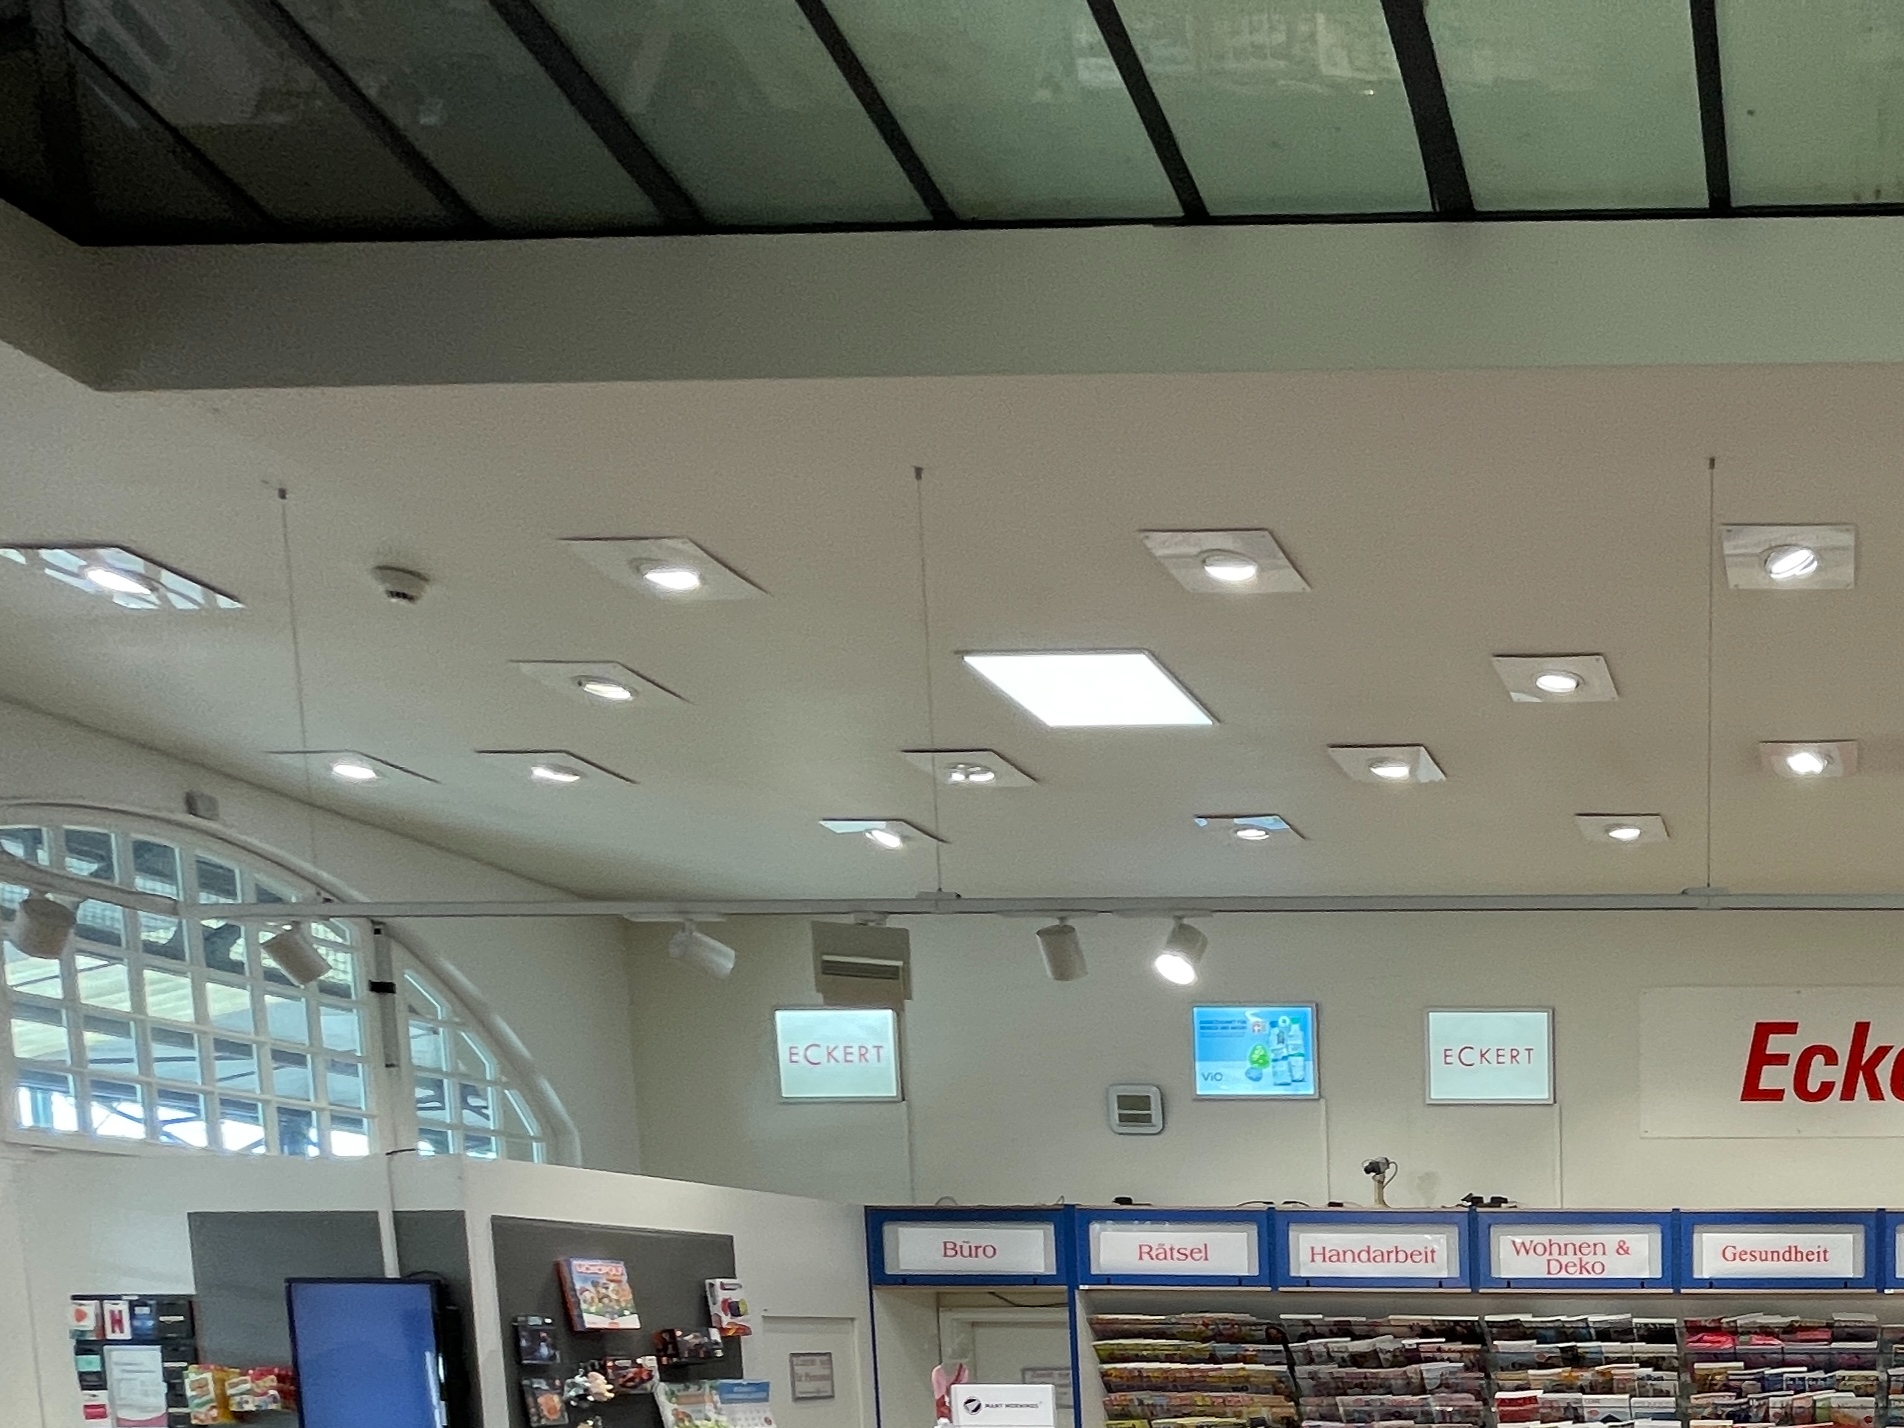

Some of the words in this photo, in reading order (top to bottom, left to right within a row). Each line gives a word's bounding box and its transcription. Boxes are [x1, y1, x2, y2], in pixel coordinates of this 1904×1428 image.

[788, 1043, 884, 1066] ECKERT
[1442, 1044, 1535, 1067] ECKERT
[942, 1240, 998, 1259] Büro
[1137, 1242, 1210, 1263] Rätsel
[1309, 1245, 1438, 1266] Handarbeit
[1511, 1240, 1608, 1259] Wohnen
[1615, 1241, 1631, 1258] &
[1721, 1244, 1830, 1266] Gesundheit
[1545, 1258, 1606, 1277] Deko
